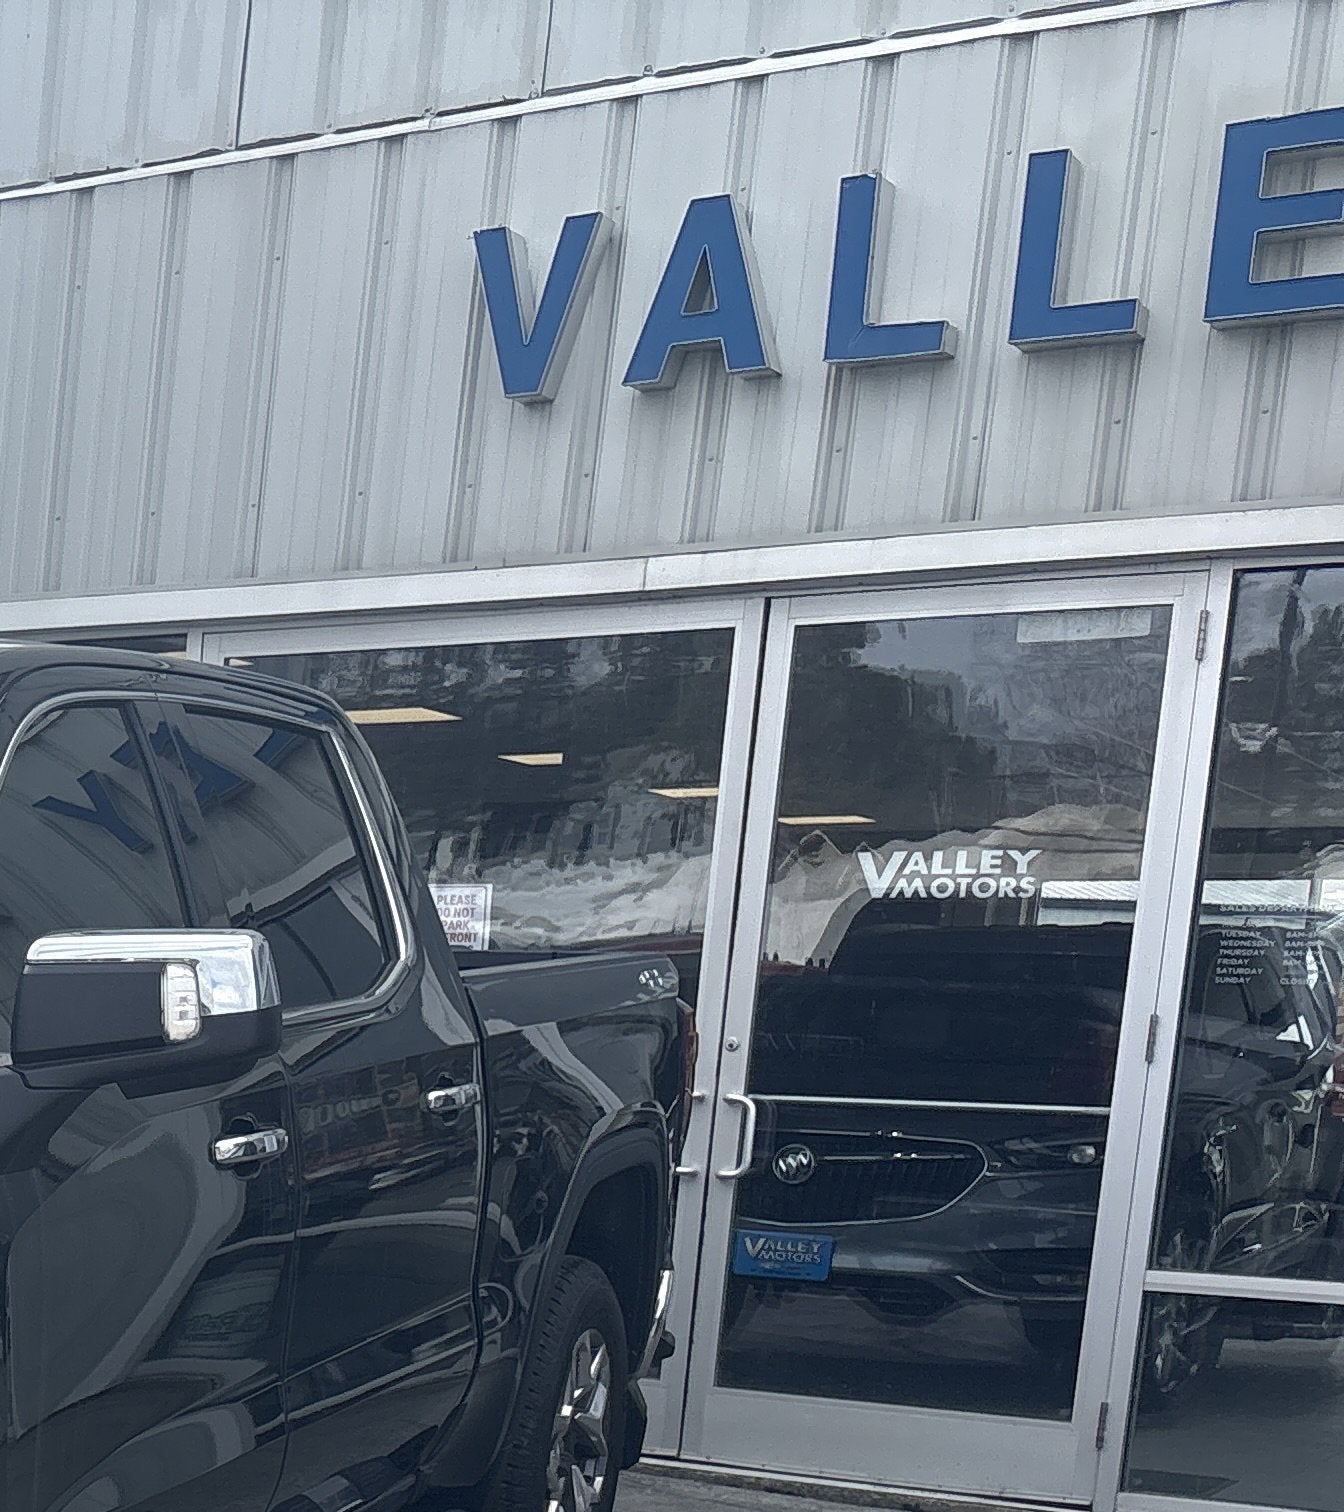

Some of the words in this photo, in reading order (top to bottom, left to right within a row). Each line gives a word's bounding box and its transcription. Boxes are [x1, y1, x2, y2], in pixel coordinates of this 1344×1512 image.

[472, 107, 1344, 404] VALLE
[857, 848, 1042, 899] VALLEY
[889, 877, 1037, 899] MOTORS
[436, 894, 477, 906] PLEASE
[453, 907, 477, 918] NOT
[1219, 903, 1255, 912] SALES
[1221, 930, 1262, 938] TUESDAY
[1216, 967, 1264, 975] SATURDAY
[1215, 976, 1251, 984] SUNDAY
[744, 1237, 823, 1257] VALLEY
[758, 1250, 821, 1264] MOTORS
